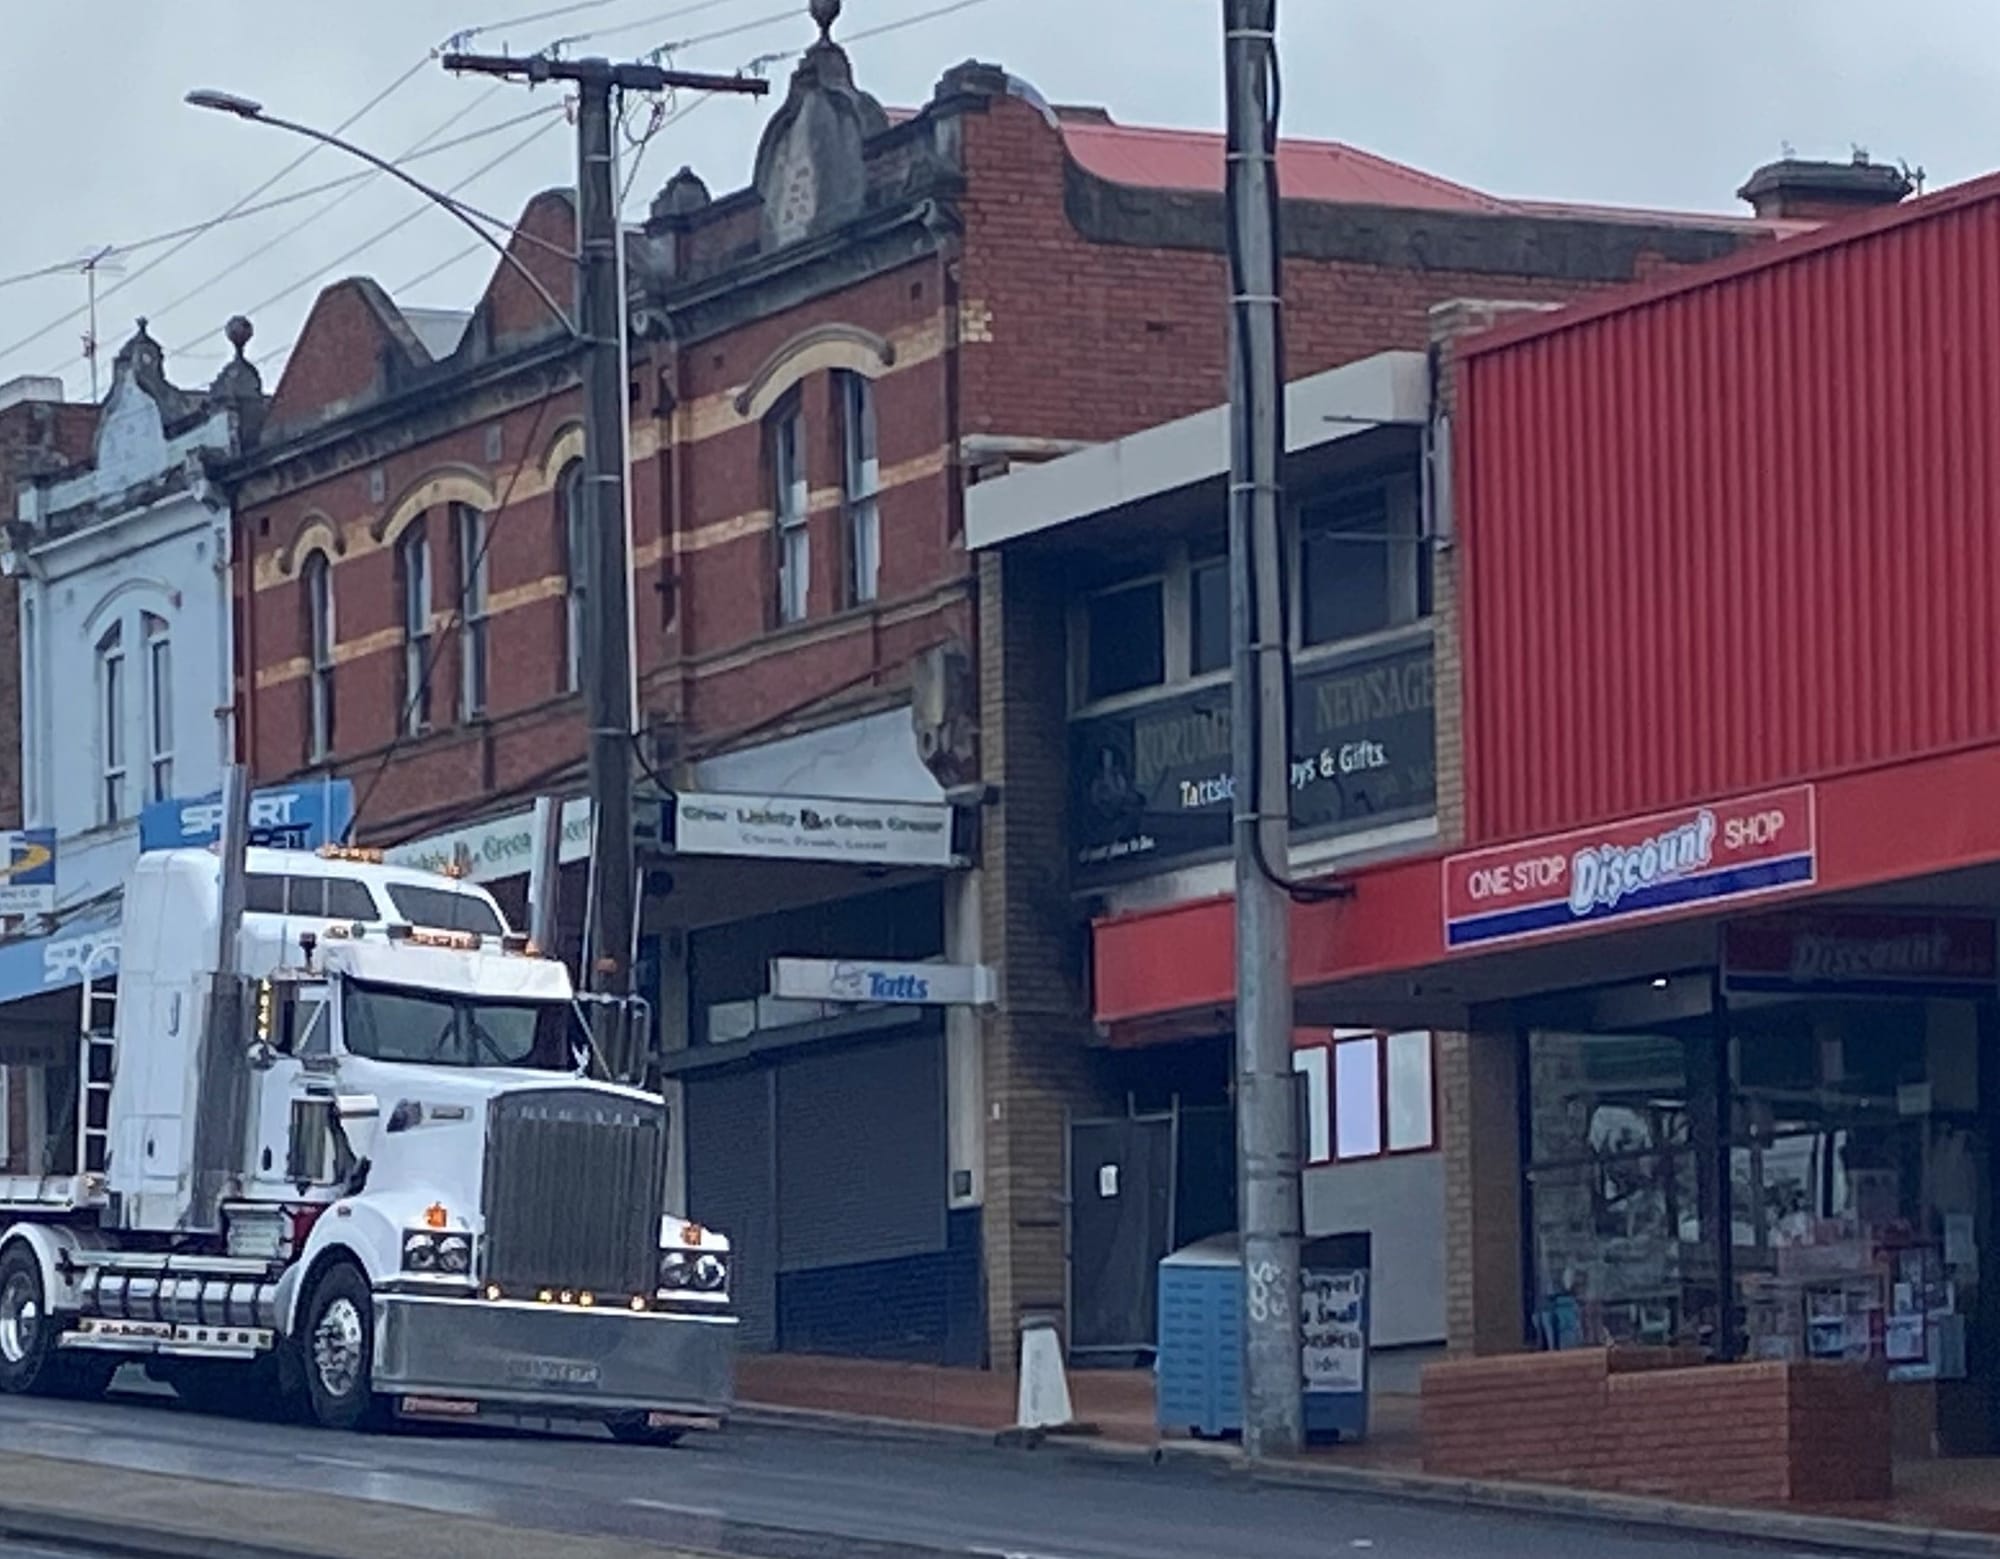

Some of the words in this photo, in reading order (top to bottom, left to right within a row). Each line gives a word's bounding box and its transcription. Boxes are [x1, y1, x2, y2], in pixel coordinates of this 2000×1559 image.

[1320, 747, 1335, 777] &
[1469, 867, 1511, 898] ONE
[1513, 856, 1566, 891] STOP
[1570, 808, 1716, 915] Discount
[1724, 810, 1785, 849] SHOP
[868, 972, 929, 998] Tatts
